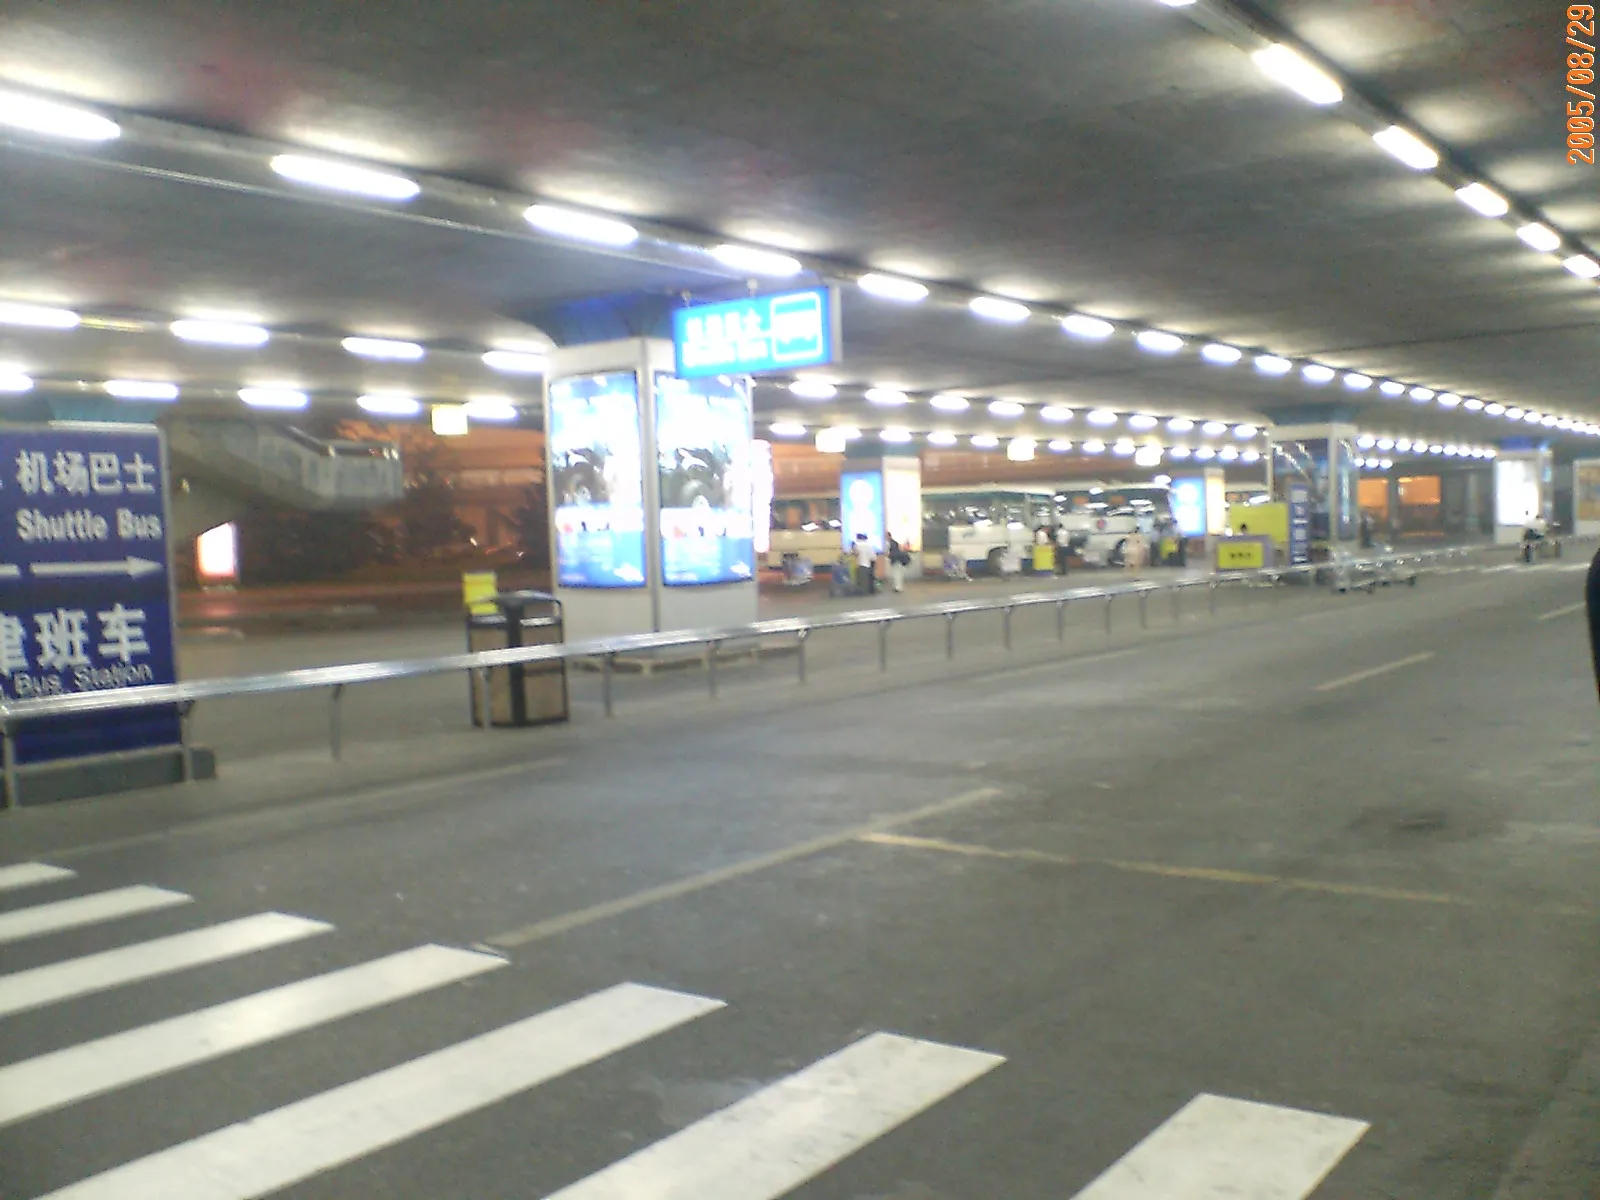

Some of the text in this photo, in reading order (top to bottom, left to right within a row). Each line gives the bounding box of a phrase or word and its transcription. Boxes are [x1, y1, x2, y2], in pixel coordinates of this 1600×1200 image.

[15, 450, 156, 496] 机场巴士
[16, 508, 163, 543] Shuttle Bus
[14, 672, 62, 698] Bus
[74, 662, 153, 692] Station
